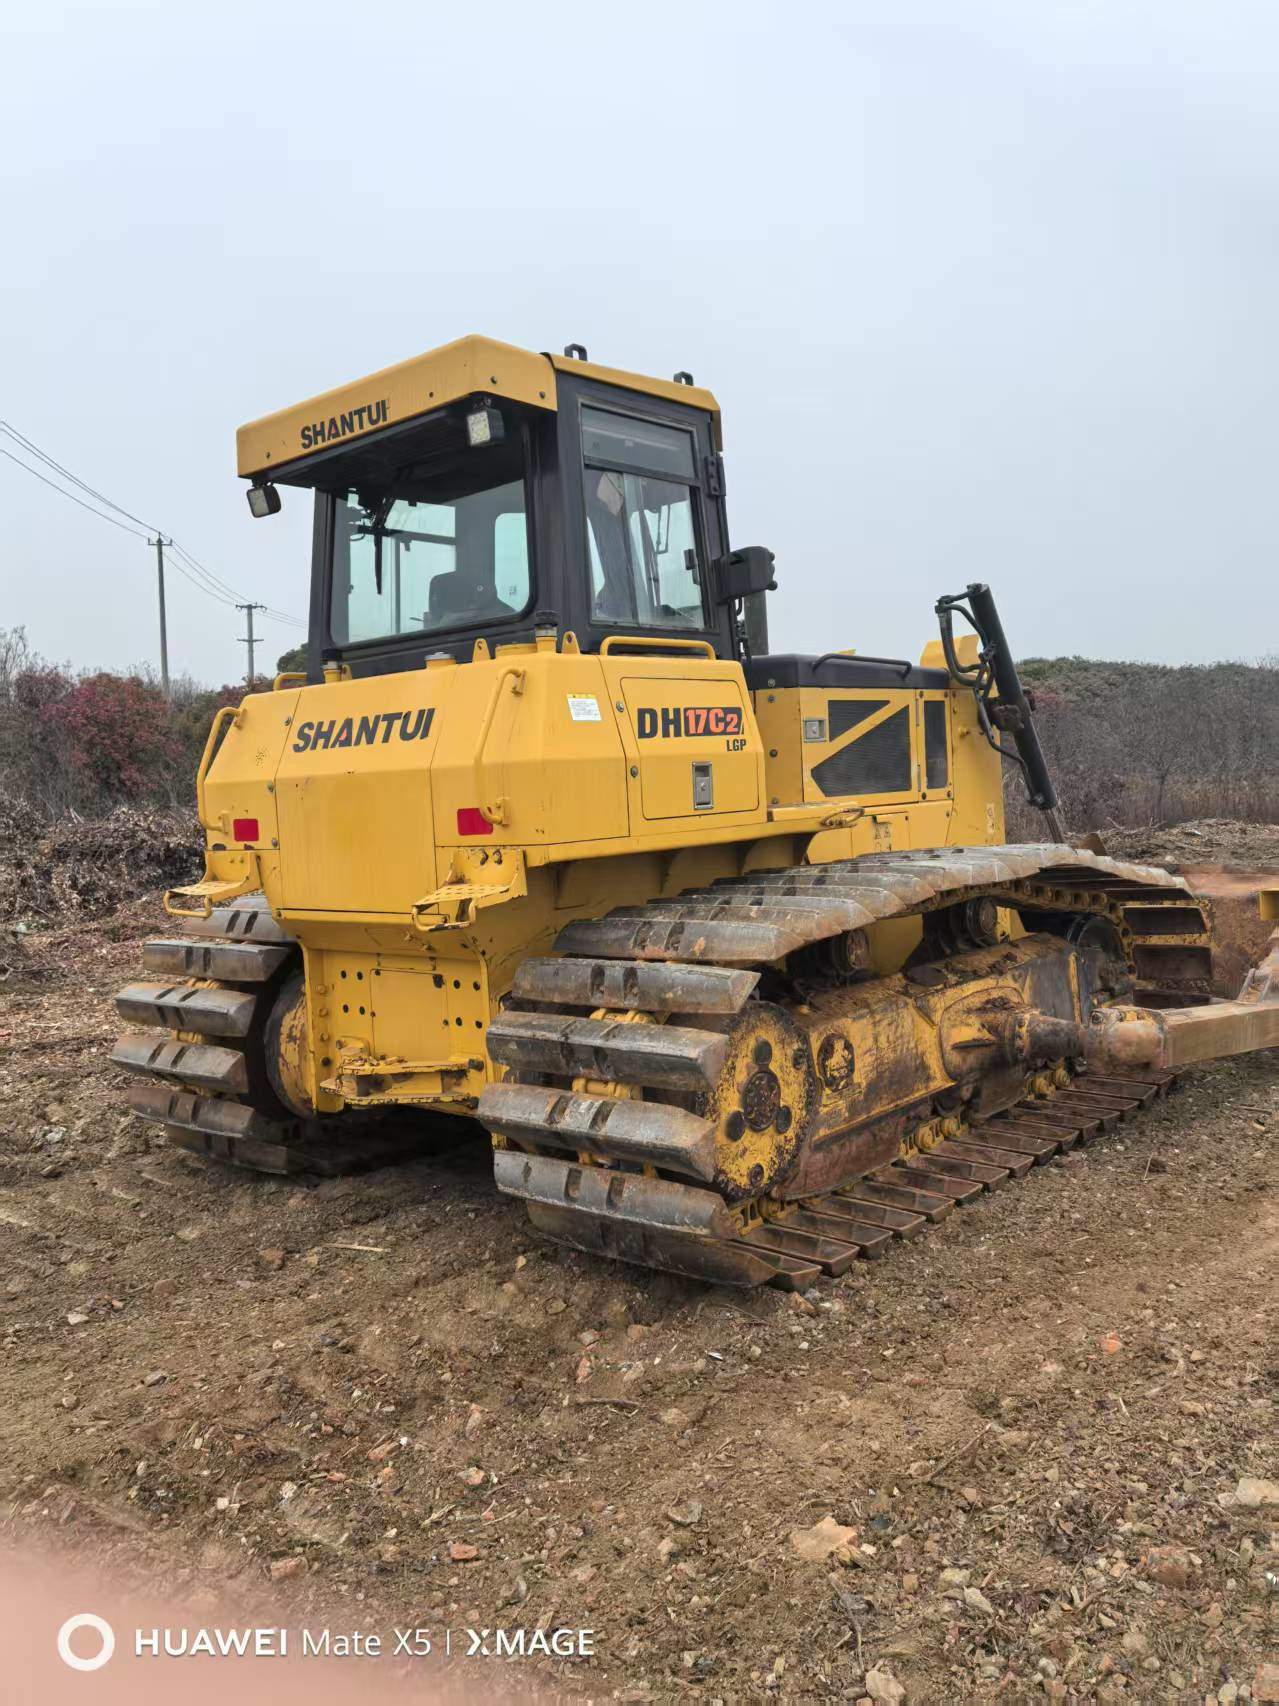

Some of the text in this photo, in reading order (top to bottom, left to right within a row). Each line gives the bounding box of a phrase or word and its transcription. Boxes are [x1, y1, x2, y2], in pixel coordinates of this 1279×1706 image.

[301, 399, 388, 449] SHANTUI
[293, 708, 436, 753] SHANTUI
[637, 707, 739, 739] DH17C2
[726, 738, 747, 752] LGP
